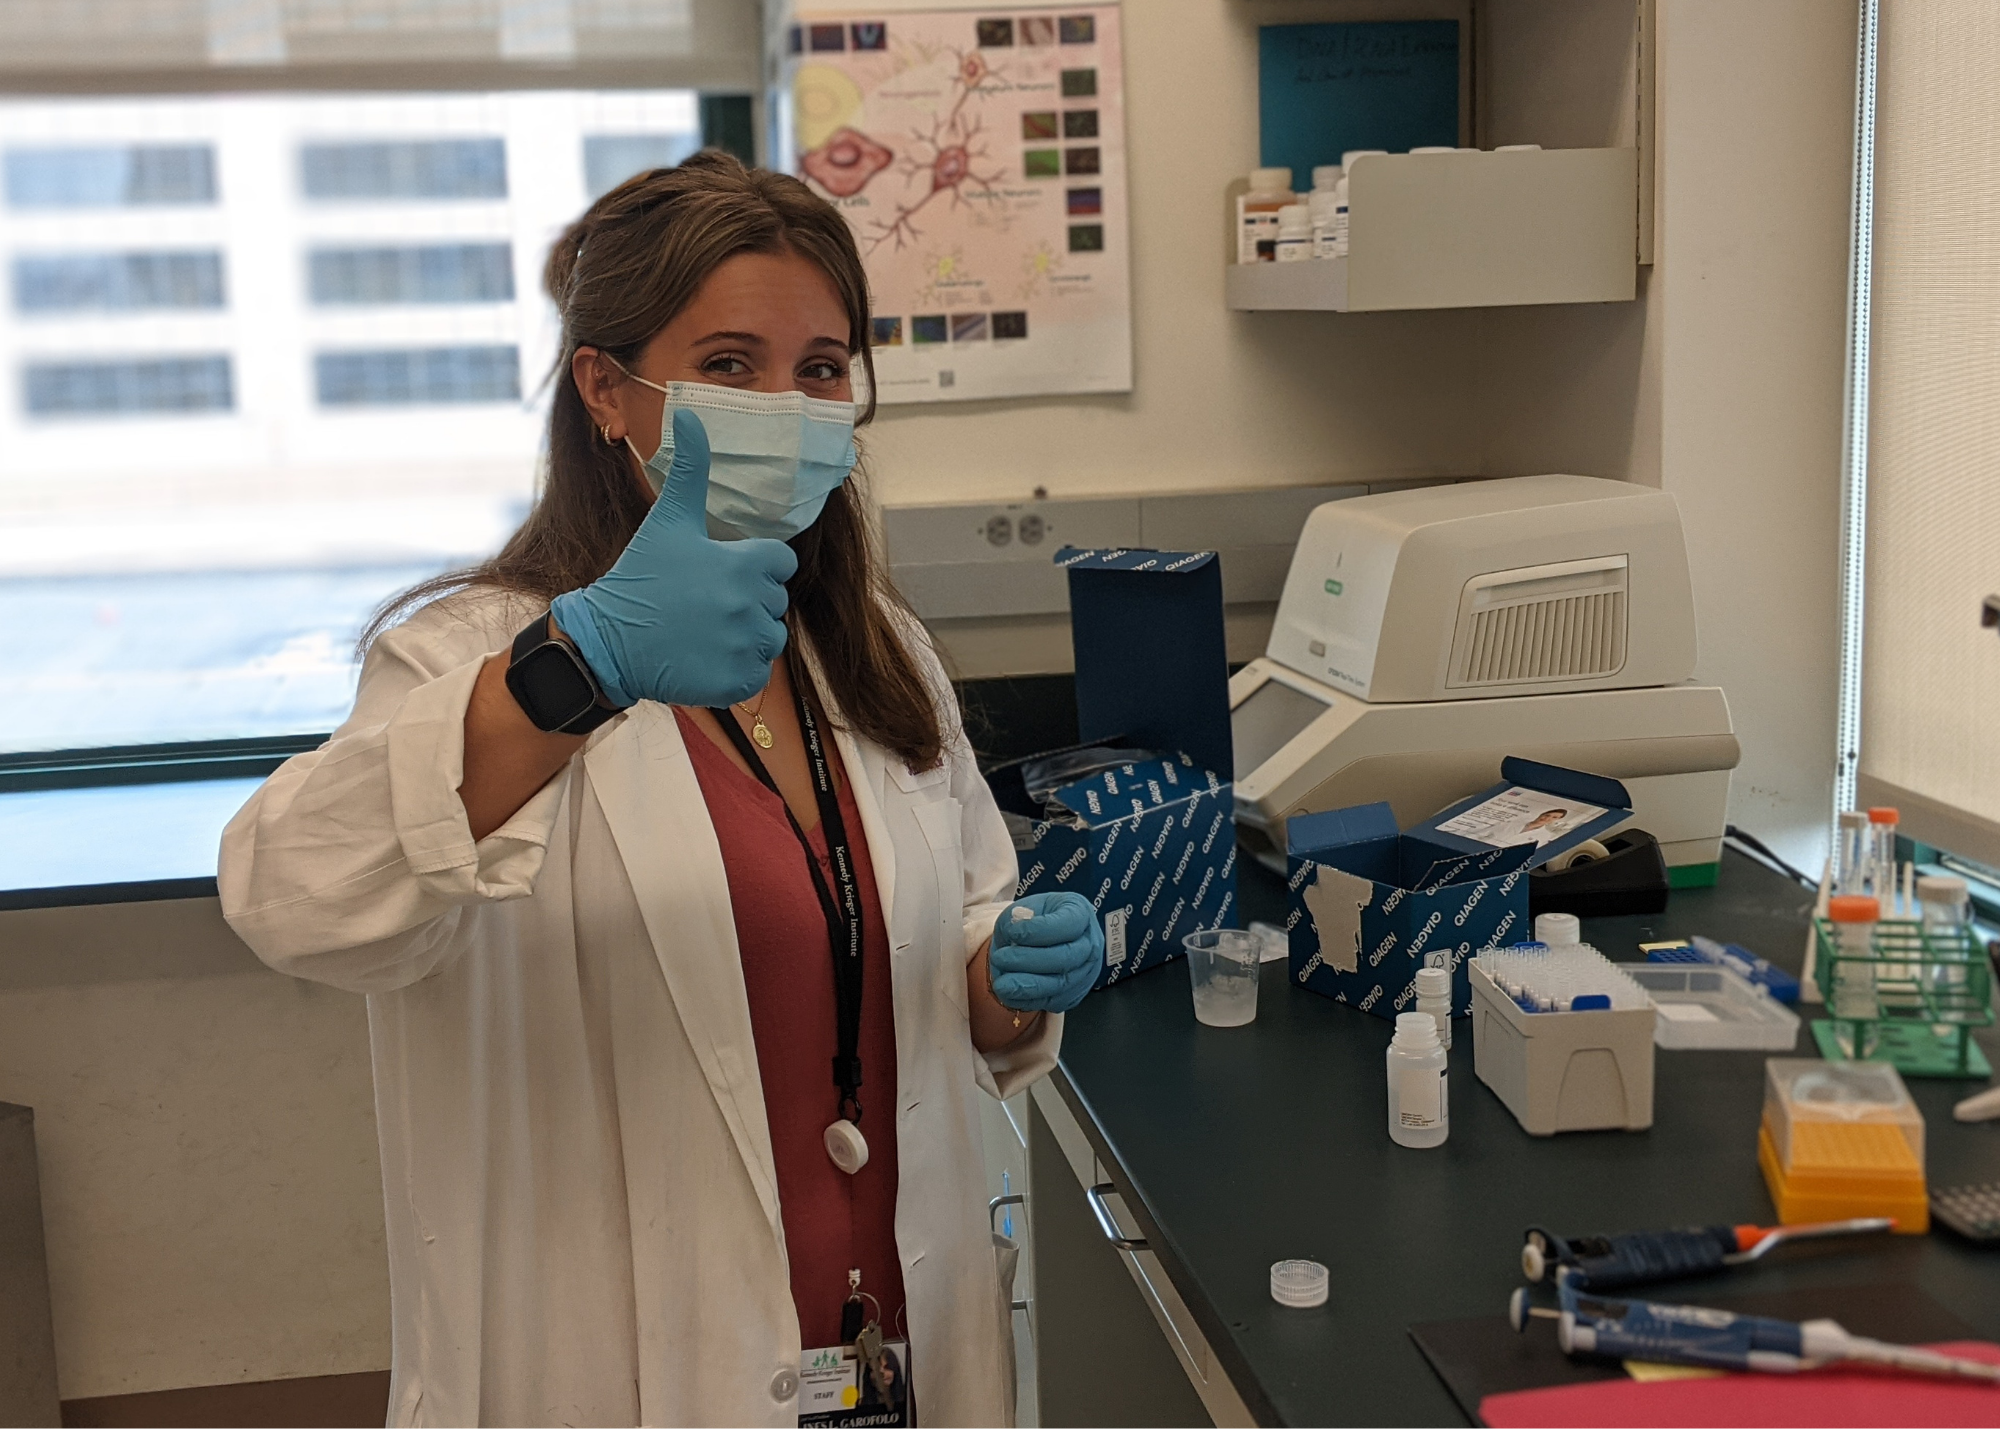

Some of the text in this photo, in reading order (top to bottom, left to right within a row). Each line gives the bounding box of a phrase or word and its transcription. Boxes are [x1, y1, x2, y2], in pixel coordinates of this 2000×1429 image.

[809, 729, 820, 757] Krieger
[815, 758, 828, 792] Institute
[1098, 820, 1122, 864] QIAGEN
[1151, 814, 1174, 860] QIAGEN
[1202, 810, 1224, 855] QIAGEN
[1014, 860, 1046, 897] QIAGEN
[1055, 847, 1087, 884] QIAGEN
[1120, 844, 1145, 891] QIAGEN
[1172, 841, 1195, 885] QIAGEN
[1288, 859, 1314, 892] QIAGEN
[1427, 859, 1470, 896] QIAGEN
[835, 845, 859, 957] Kennedy Krieger Institute
[1141, 871, 1166, 917] QIAGEN
[1191, 866, 1215, 910] QIAGEN
[1454, 880, 1489, 927] QIAGEN
[1161, 896, 1185, 941] QIAGEN
[1406, 911, 1442, 959] QIAGEN
[1129, 929, 1154, 975] QIAGEN
[1368, 931, 1398, 967] QIAGEN
[814, 1391, 835, 1400] STAFF
[840, 1412, 900, 1429] GAROFOLO
